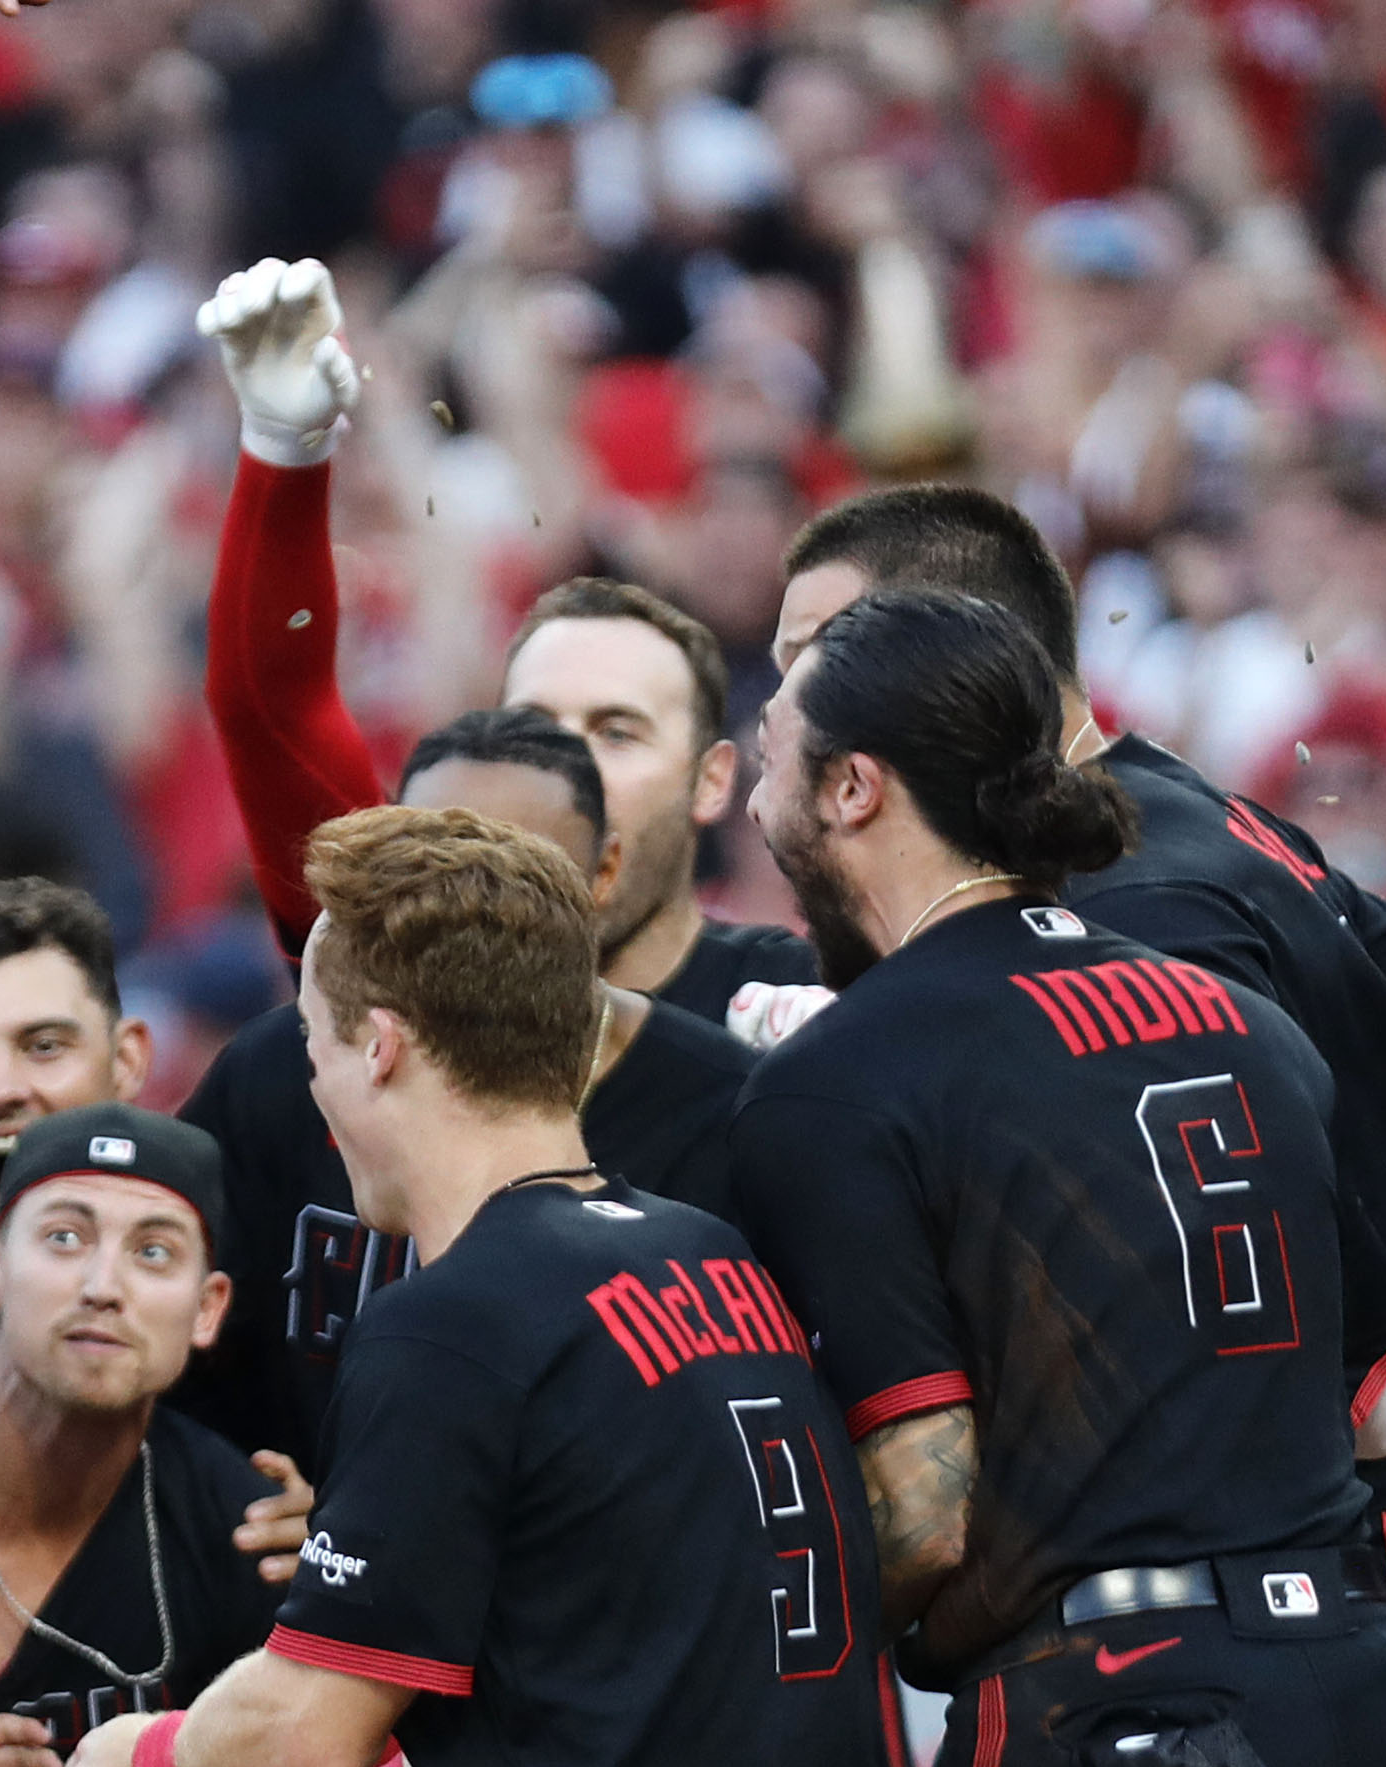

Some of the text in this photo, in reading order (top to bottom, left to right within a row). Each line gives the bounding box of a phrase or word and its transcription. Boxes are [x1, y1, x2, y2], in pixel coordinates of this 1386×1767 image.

[1009, 958, 1248, 1057] INDIA
[1135, 1072, 1301, 1355] 6
[298, 1530, 368, 1585] Kroger
[728, 1396, 854, 1683] 9
